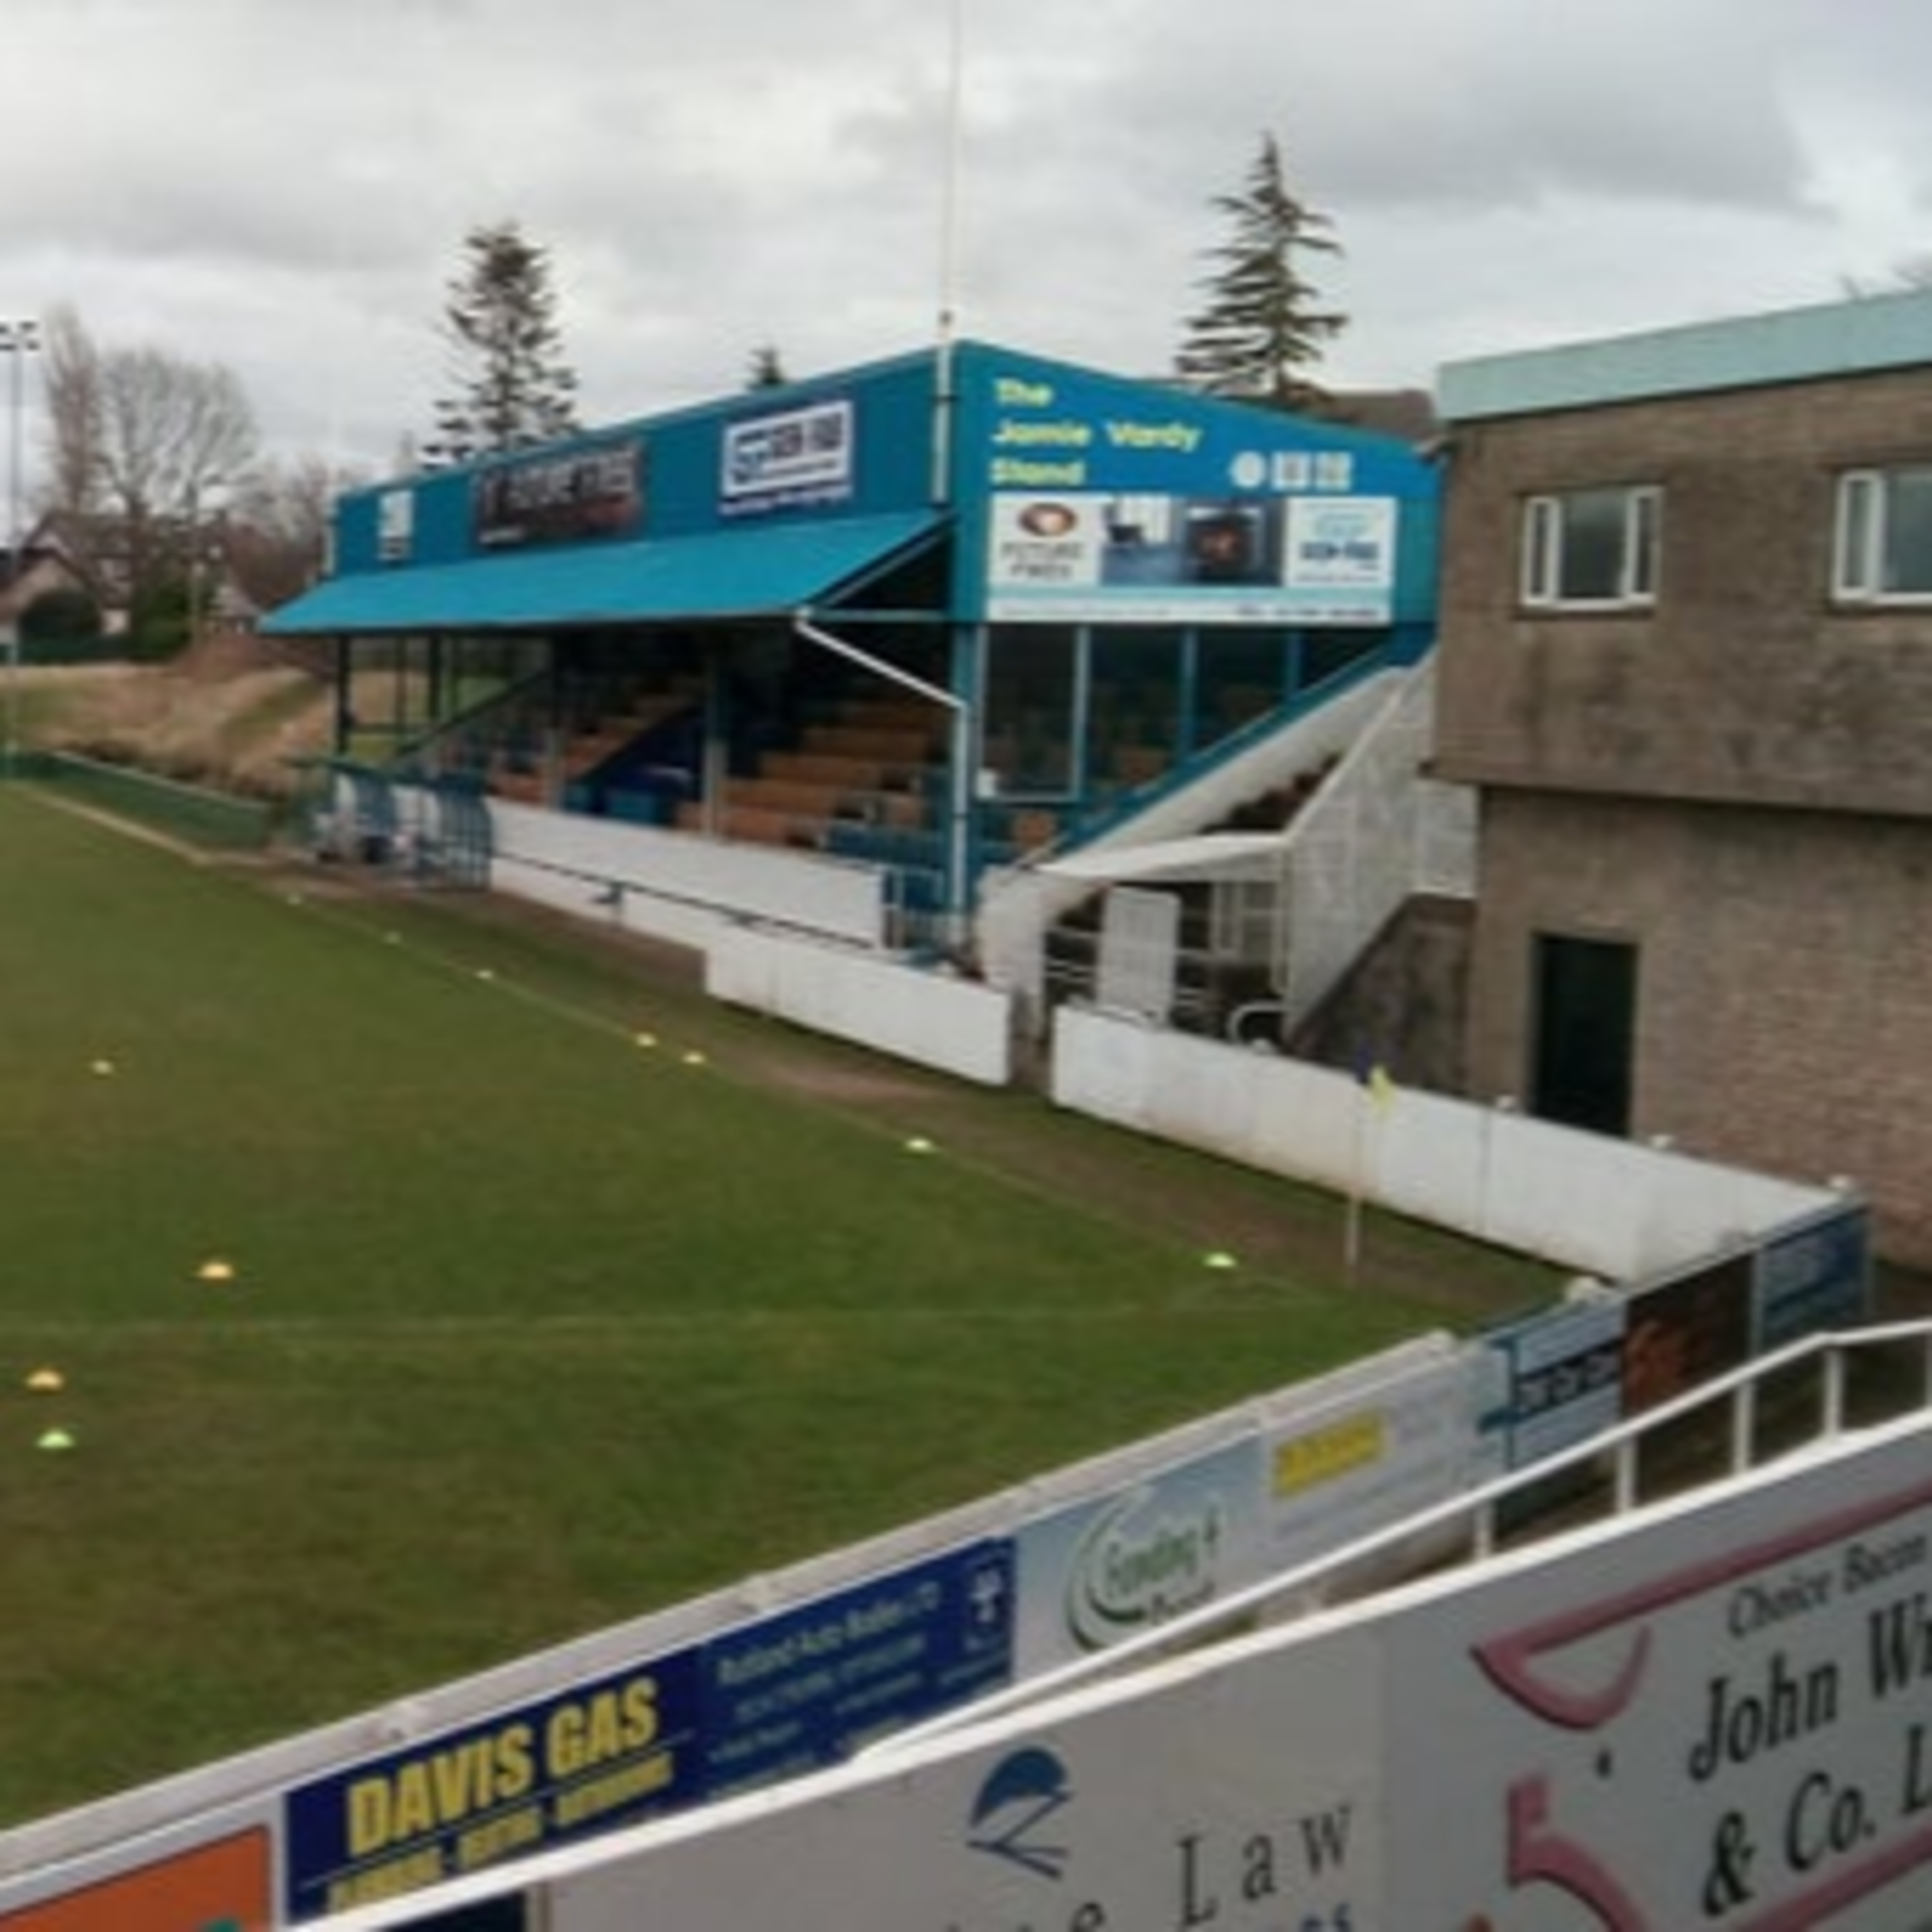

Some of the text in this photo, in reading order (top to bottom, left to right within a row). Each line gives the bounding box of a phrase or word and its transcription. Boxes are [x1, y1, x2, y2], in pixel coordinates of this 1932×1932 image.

[1727, 1567, 1833, 1638] Choice
[348, 1723, 535, 1860] DAVIS
[546, 1676, 658, 1778] GAS
[1687, 1649, 1839, 1783] John
[1176, 1803, 1354, 1928] Law
[1701, 1810, 1757, 1918] &
[1783, 1770, 1877, 1873] Co.
